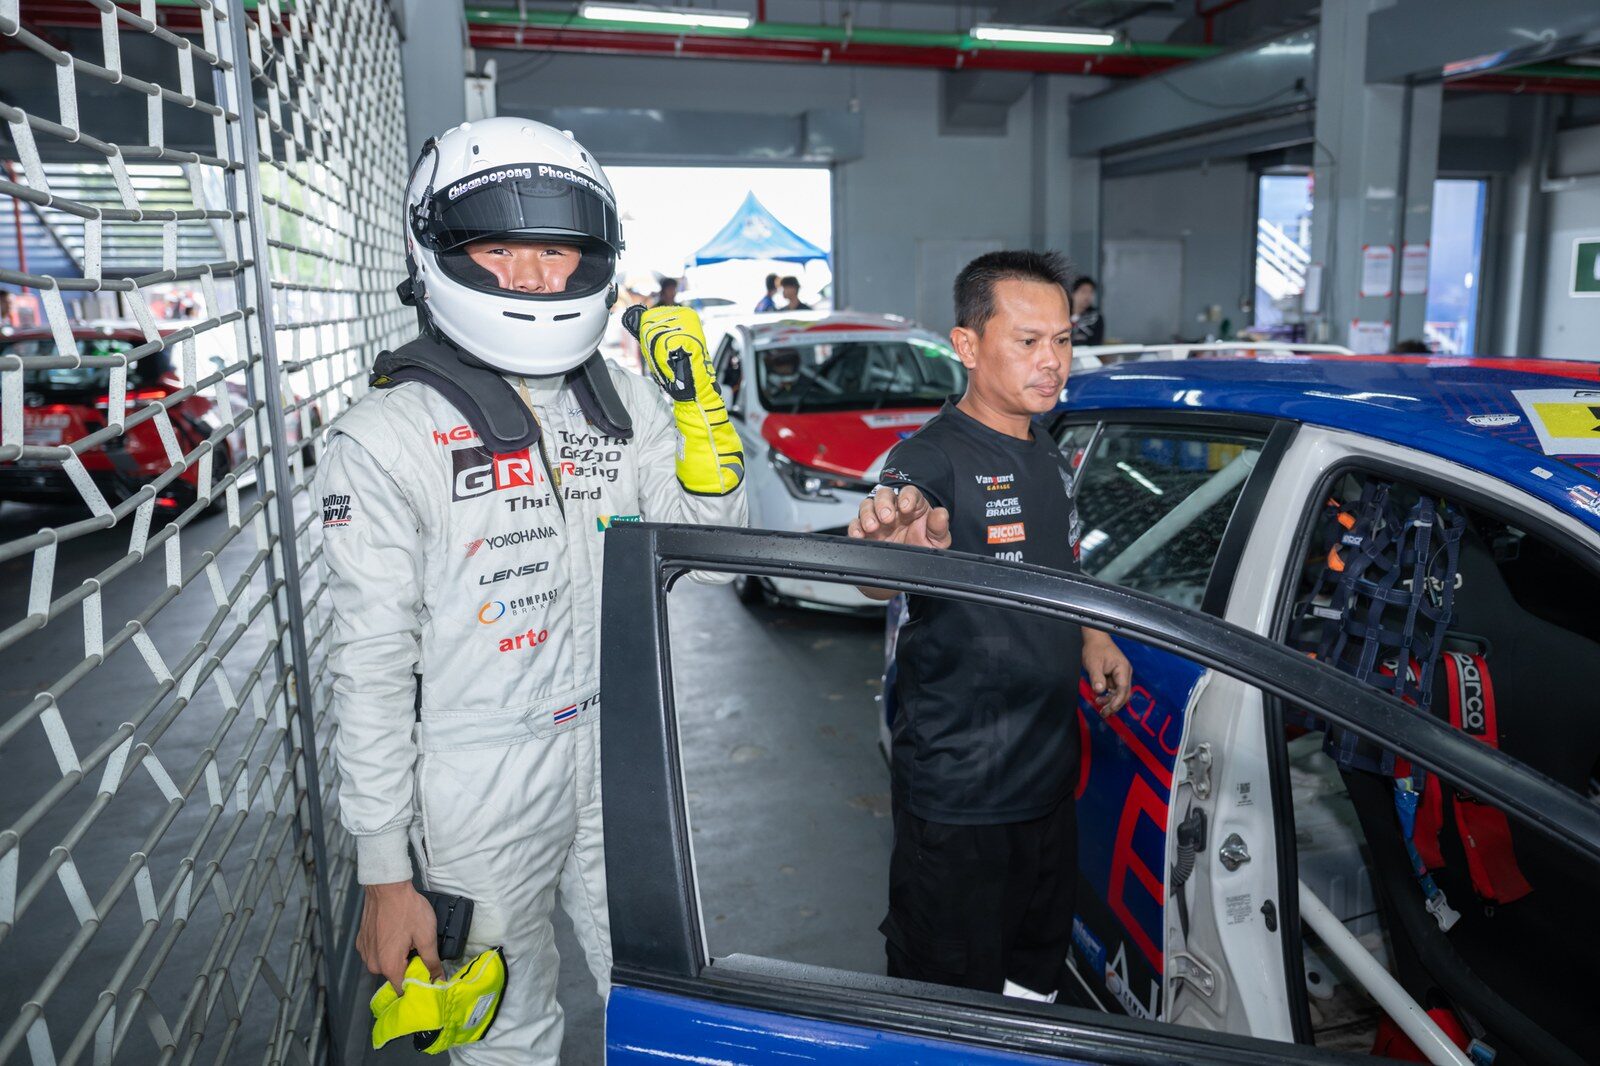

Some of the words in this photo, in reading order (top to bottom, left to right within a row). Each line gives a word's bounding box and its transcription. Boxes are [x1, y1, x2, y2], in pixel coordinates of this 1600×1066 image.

[455, 457, 533, 498] GR
[975, 473, 1015, 485] Vanguard
[985, 506, 1022, 517] BRAKES
[486, 526, 558, 551] YOKOHAMA
[989, 524, 1025, 539] RICOTA
[479, 560, 550, 586] LENSO
[510, 588, 558, 610] COMPACT
[499, 629, 549, 653] arto
